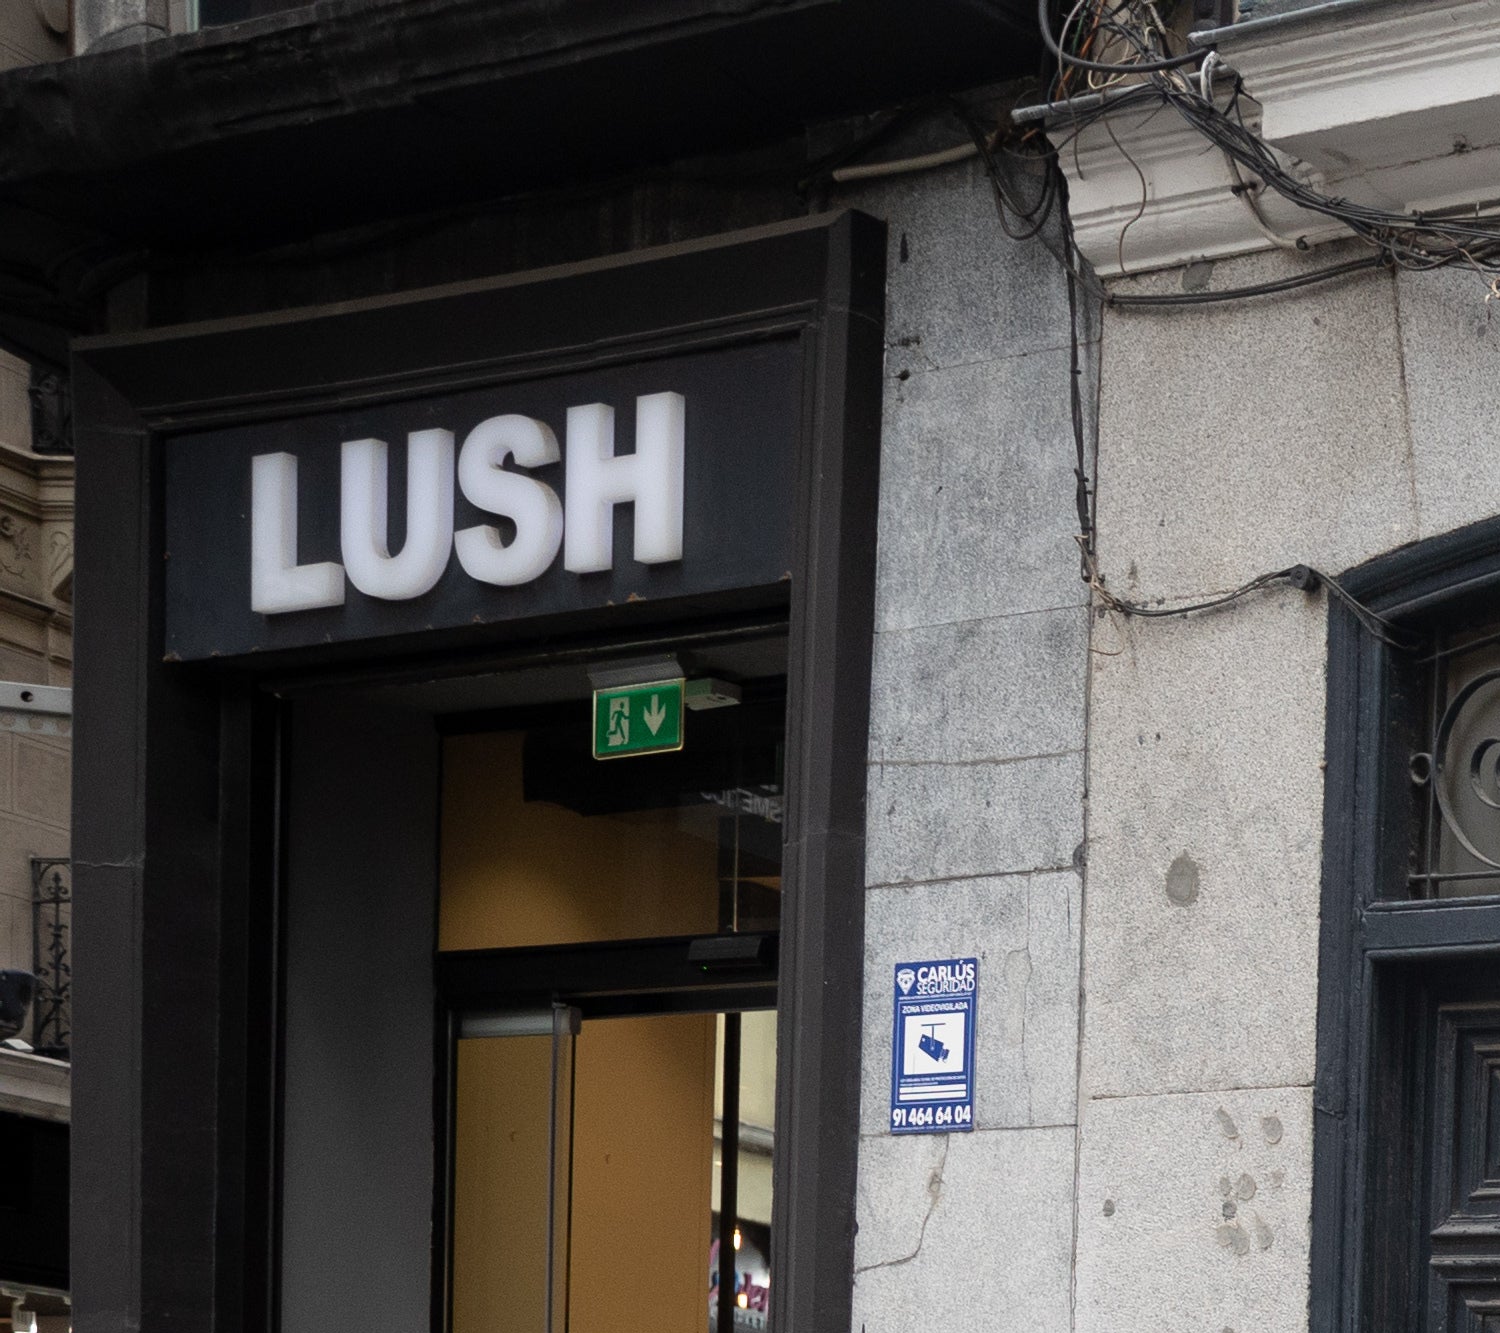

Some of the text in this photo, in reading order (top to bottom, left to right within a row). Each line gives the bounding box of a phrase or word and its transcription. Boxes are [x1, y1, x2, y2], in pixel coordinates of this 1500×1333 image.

[249, 389, 686, 615] LUSH
[916, 959, 975, 982] CARLÚS
[916, 978, 976, 996] SEGURIDAD
[902, 1004, 921, 1014] ZONA
[893, 1108, 907, 1127] 91
[908, 1107, 934, 1127] 464
[935, 1106, 953, 1125] 64
[954, 1104, 972, 1124] 04
